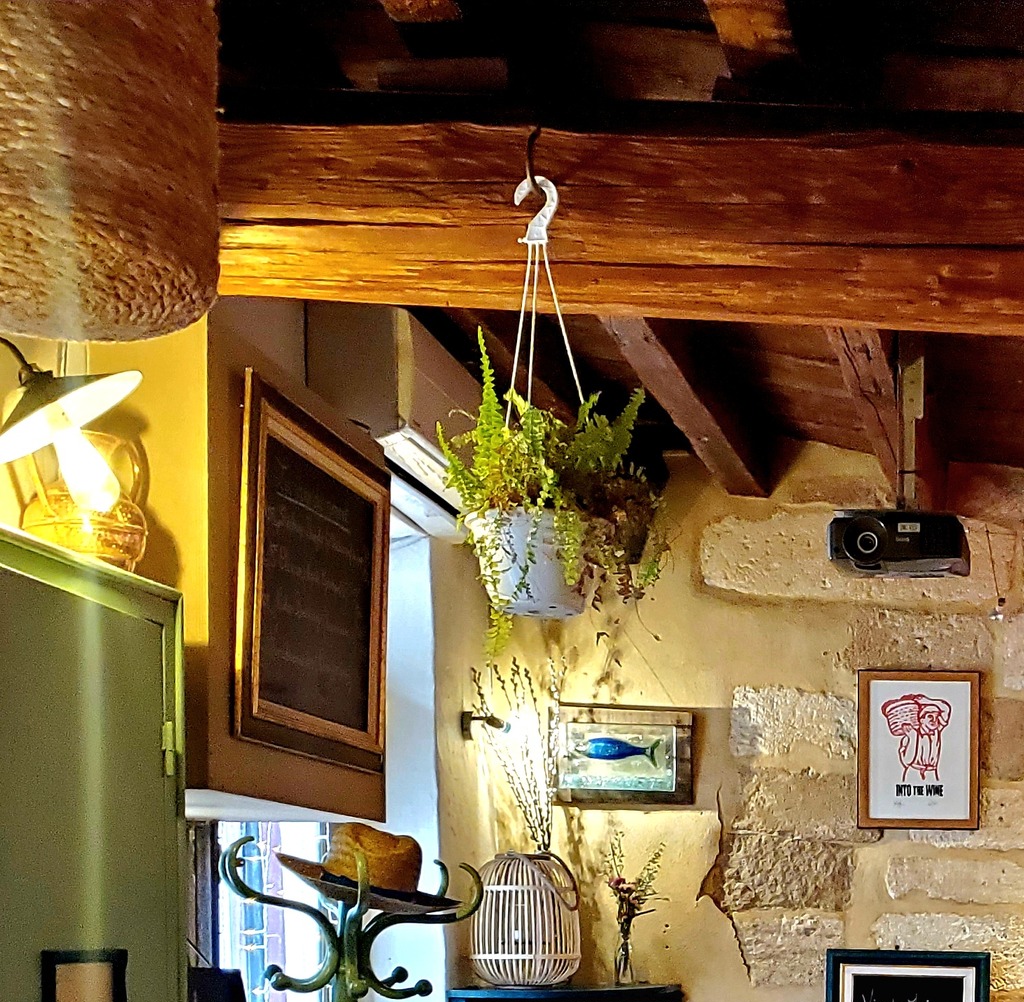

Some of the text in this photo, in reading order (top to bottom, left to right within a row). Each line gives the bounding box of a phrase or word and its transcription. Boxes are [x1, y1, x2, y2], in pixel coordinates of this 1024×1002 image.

[896, 784, 944, 797] INTO THE WINE
